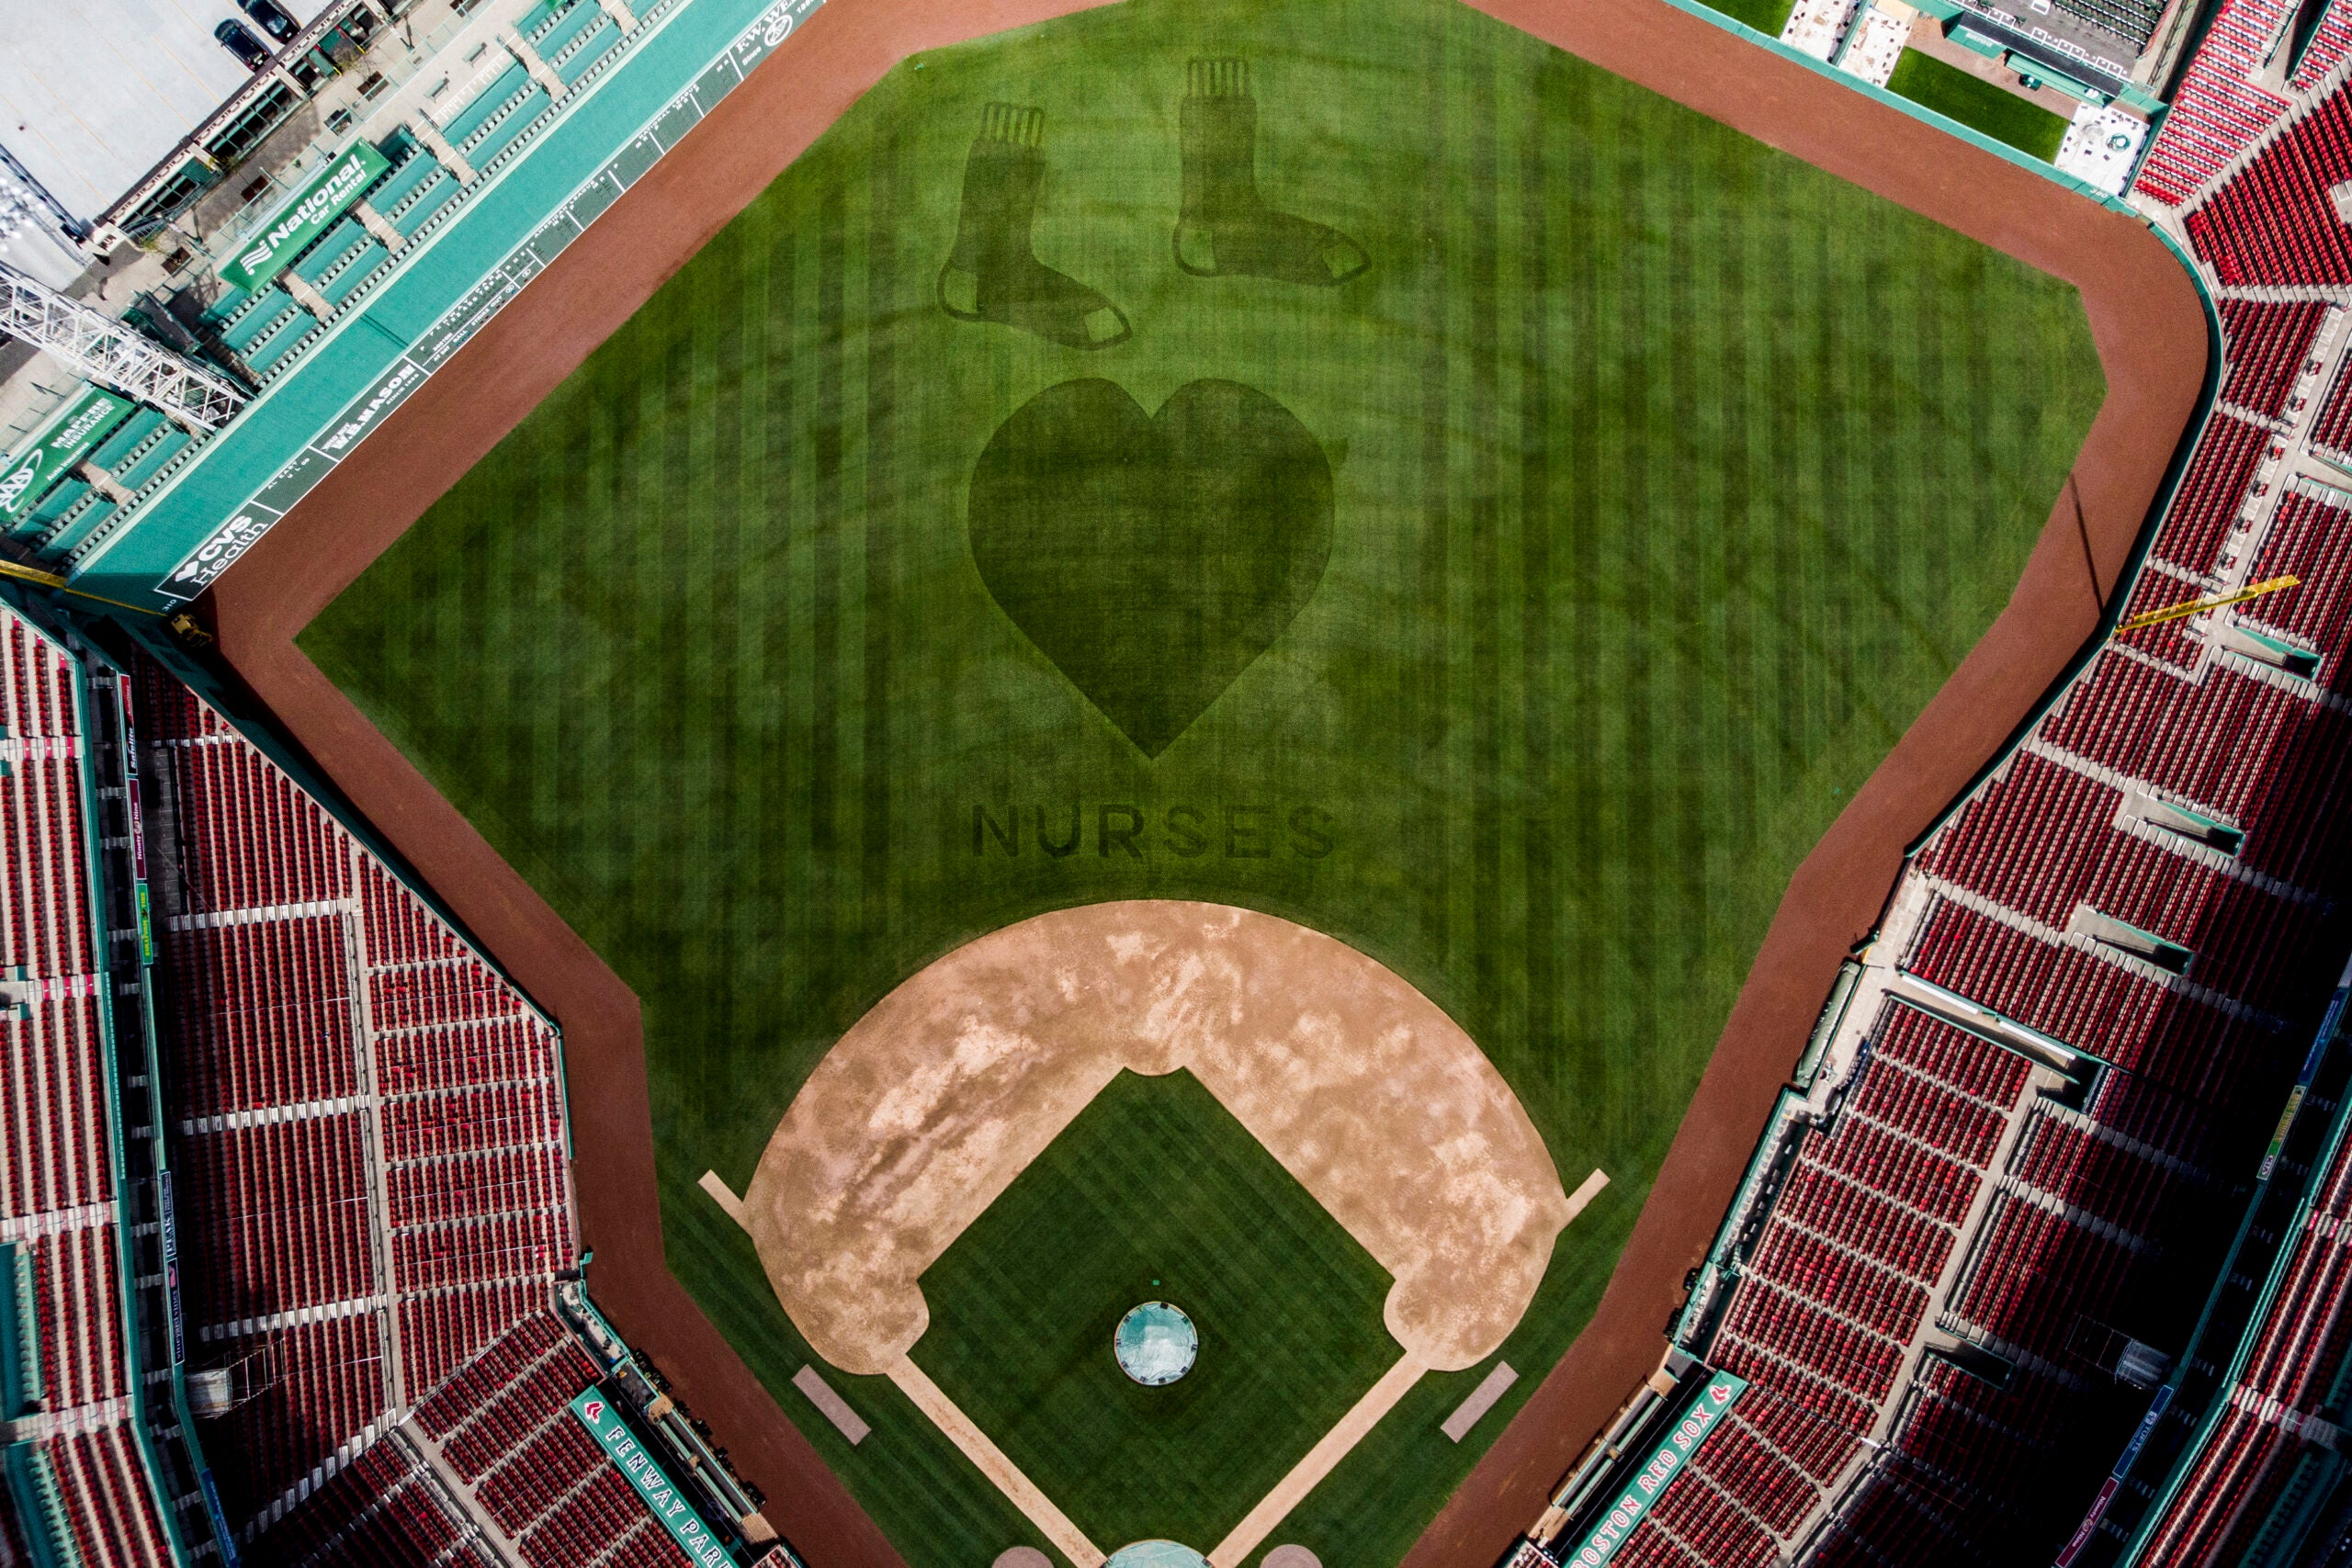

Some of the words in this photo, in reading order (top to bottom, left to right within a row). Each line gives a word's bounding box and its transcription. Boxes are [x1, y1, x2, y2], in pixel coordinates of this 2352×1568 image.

[741, 45, 763, 65] Since
[638, 108, 671, 139] NATIONAL
[672, 83, 697, 107] LEAGUE
[266, 154, 363, 247] National
[309, 203, 332, 225] Car
[329, 168, 368, 206] Rental
[533, 205, 568, 238] AMERICAN
[569, 179, 594, 204] LEAGUE
[429, 298, 469, 335] FENWAY
[474, 268, 501, 293] PARK
[470, 307, 490, 325] STRIKE
[490, 295, 503, 307] OUT
[432, 332, 453, 351] BOSTON
[439, 344, 450, 355] BAT
[452, 328, 467, 343] BALL
[385, 386, 405, 404] SINCE
[51, 396, 109, 446] MAPFRE
[63, 403, 115, 448] INSURANCE
[46, 465, 62, 481] Auto
[61, 440, 89, 468] Insurance
[266, 479, 277, 490] AL
[278, 460, 298, 479] EAST
[188, 519, 268, 585] Health
[197, 513, 253, 562] CVS
[161, 597, 176, 612] 310
[972, 803, 1335, 859] NURSES
[2261, 1156, 2273, 1173] KIA
[1635, 1446, 1679, 1495] RED
[1669, 1401, 1715, 1451] SOX
[605, 1424, 685, 1520] FENWAY
[2089, 1495, 2106, 1518] Ninety
[2071, 1530, 2085, 1547] Nine
